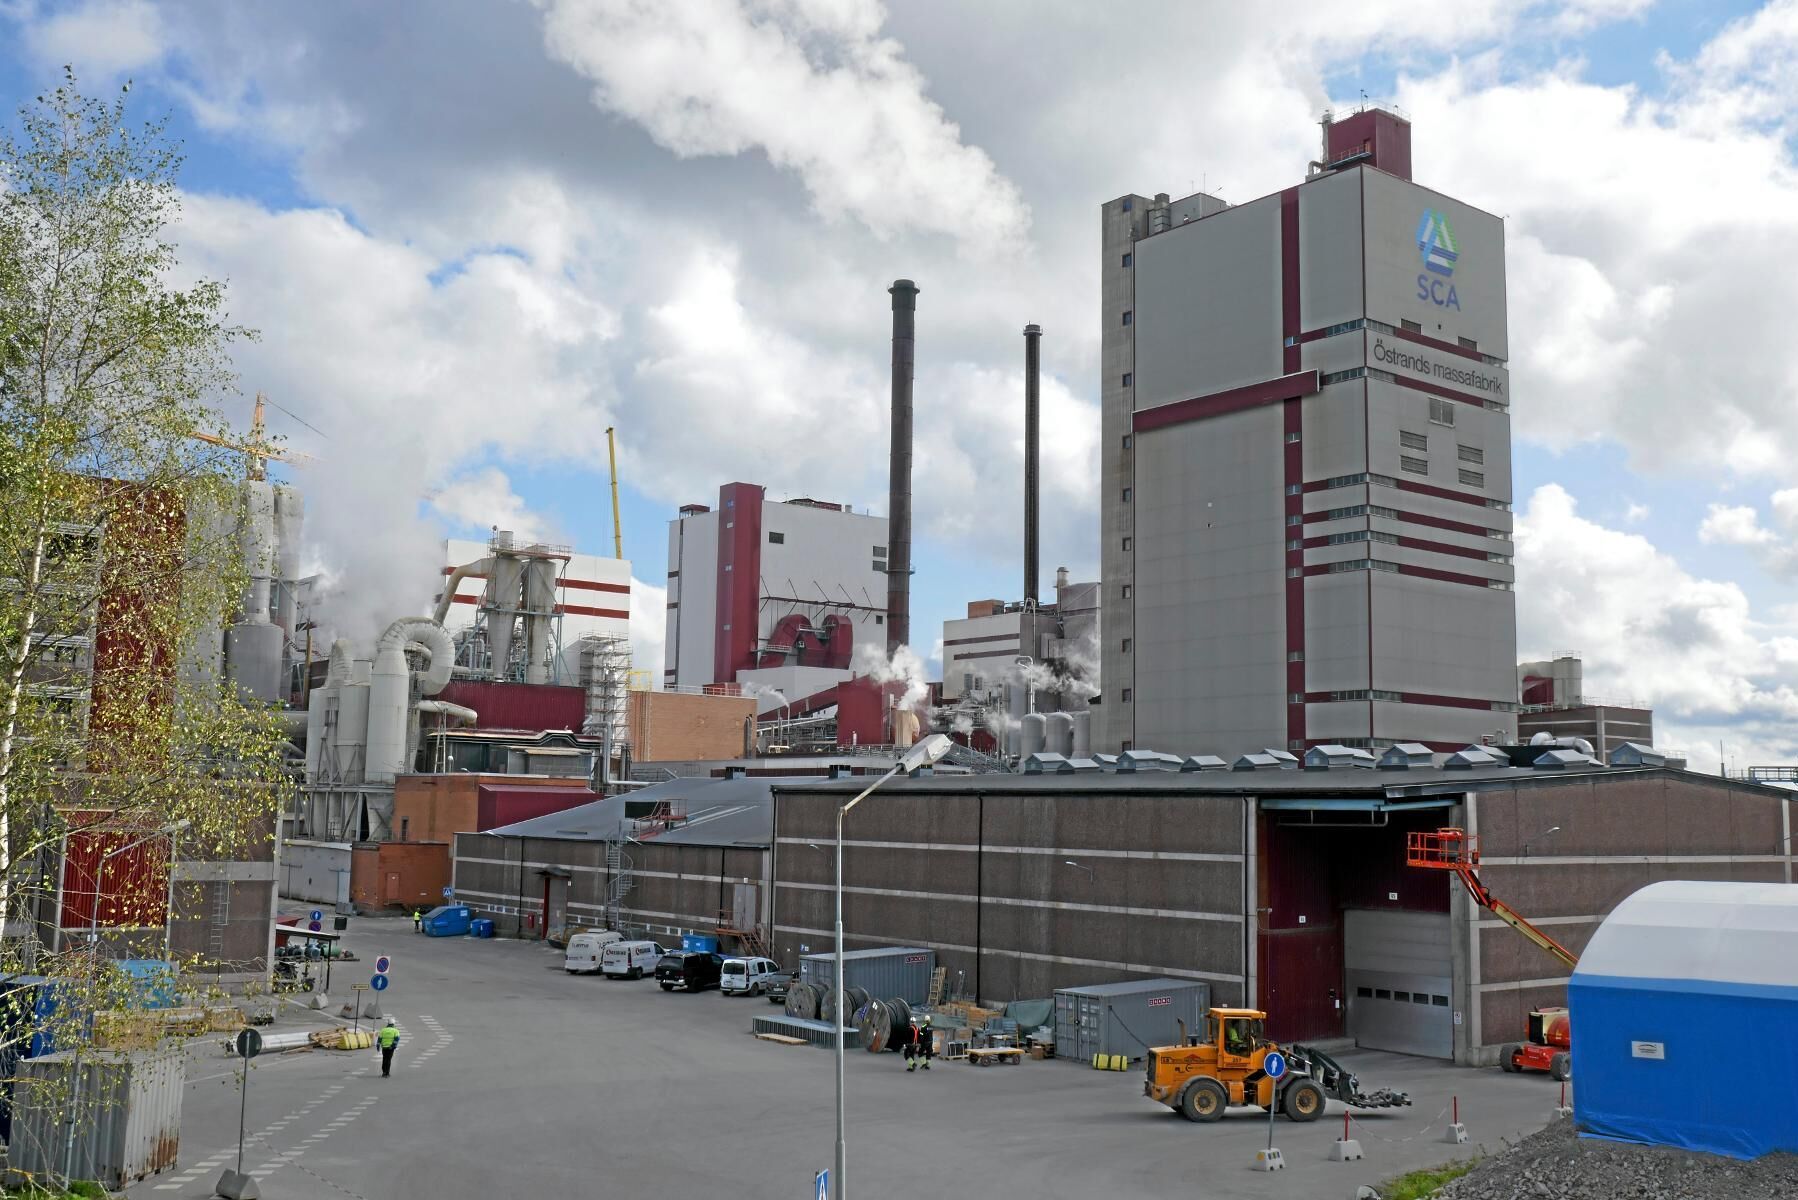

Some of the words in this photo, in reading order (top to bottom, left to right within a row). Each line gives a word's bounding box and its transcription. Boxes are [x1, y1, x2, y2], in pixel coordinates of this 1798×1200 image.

[1417, 274, 1461, 312] SCA
[1374, 338, 1430, 375] Östrands
[1433, 363, 1503, 395] massafabrik
